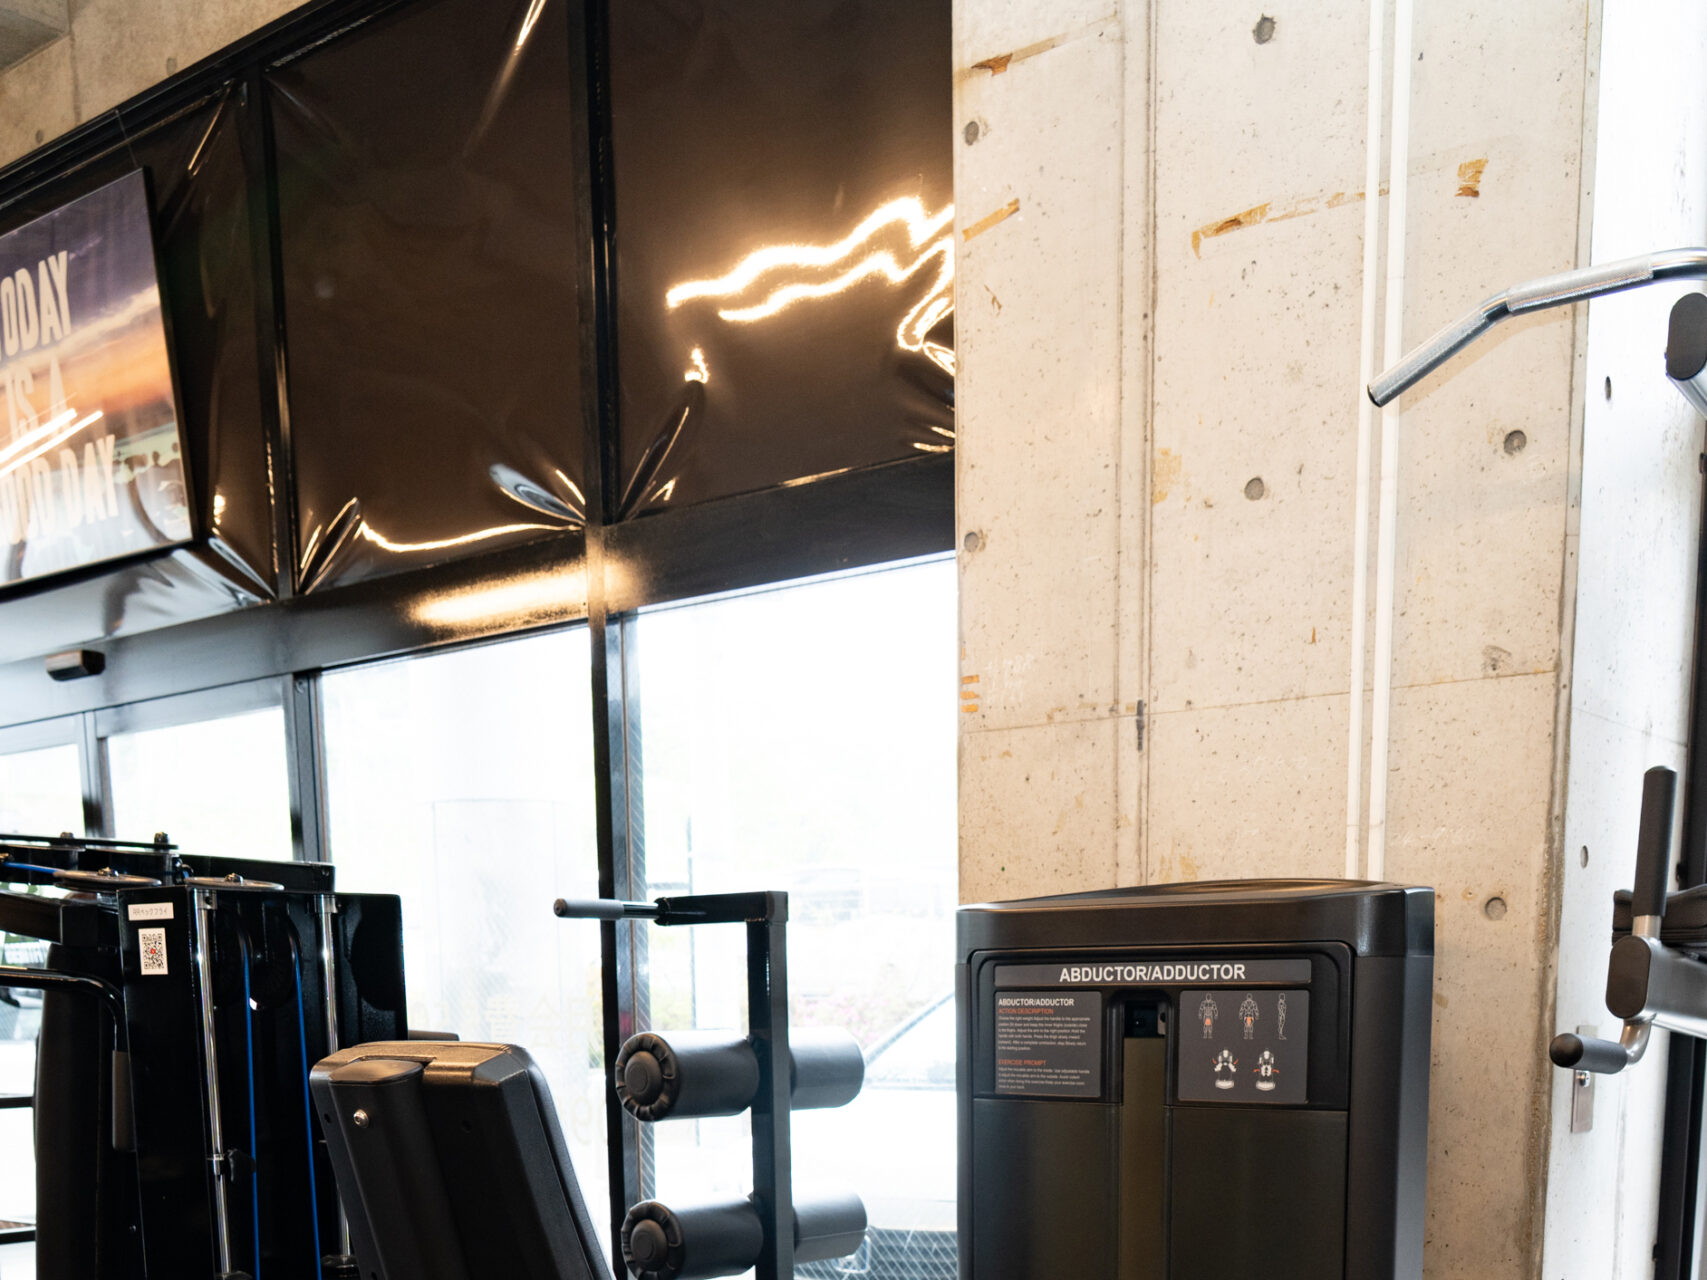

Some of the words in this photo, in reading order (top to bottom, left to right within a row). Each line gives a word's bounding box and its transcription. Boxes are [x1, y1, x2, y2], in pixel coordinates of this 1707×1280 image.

[0, 250, 72, 360] ODAY
[0, 457, 56, 545] OOD
[60, 434, 119, 529] DAY
[998, 998, 1075, 1006] ABDUCTOR/ADDUCTOR
[1059, 963, 1246, 982] ABDUCTOR/ADDUCTOR
